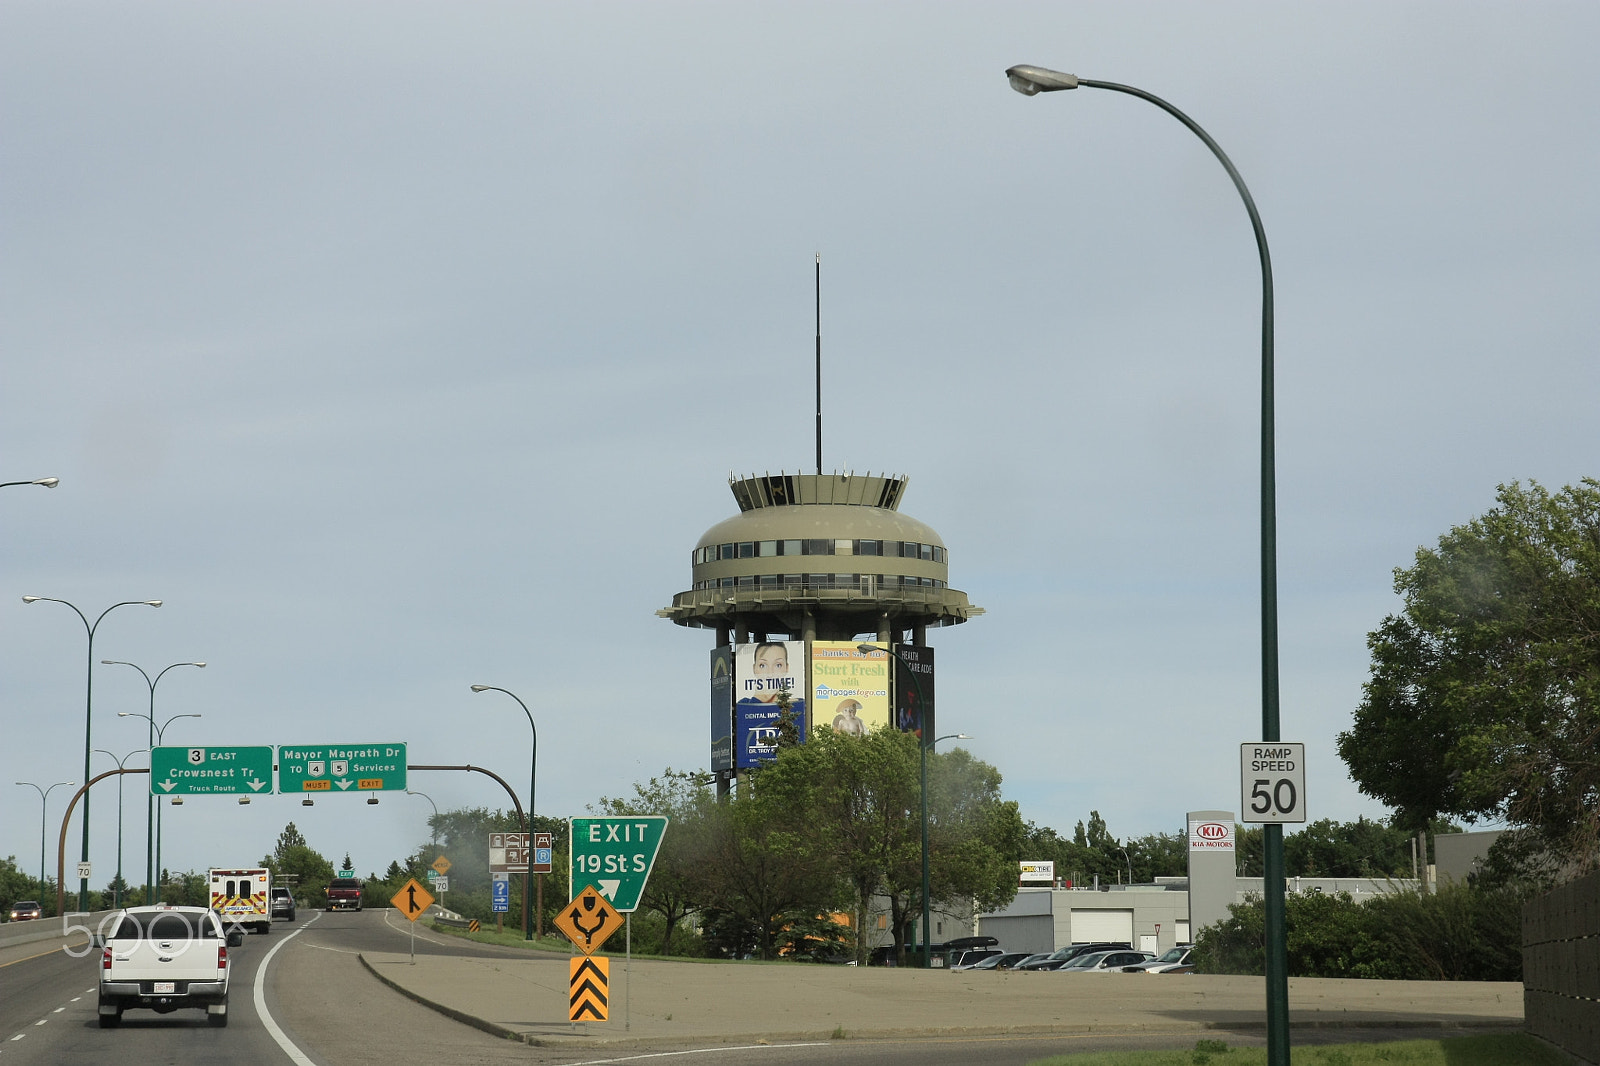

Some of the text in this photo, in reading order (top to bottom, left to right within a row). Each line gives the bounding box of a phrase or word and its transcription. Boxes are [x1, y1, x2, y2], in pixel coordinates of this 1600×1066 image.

[902, 650, 918, 660] HEALTH
[814, 663, 885, 676] Start Fresh
[908, 662, 920, 672] CARE
[744, 677, 794, 690] IT'S TIME!
[841, 678, 860, 686] with
[816, 688, 886, 698] mortgagestogo.ca
[192, 750, 201, 762] 3
[284, 748, 400, 760] Mayor Magrath Dr
[1254, 748, 1292, 759] RAMP
[353, 763, 396, 772] Services
[1252, 760, 1295, 772] SPEED
[169, 768, 254, 778] Crowsnest Tr
[1251, 778, 1296, 814] 50
[589, 824, 648, 842] EXIT
[1202, 826, 1224, 836] KIA
[576, 854, 646, 873] 19 St S
[78, 868, 90, 876] 70
